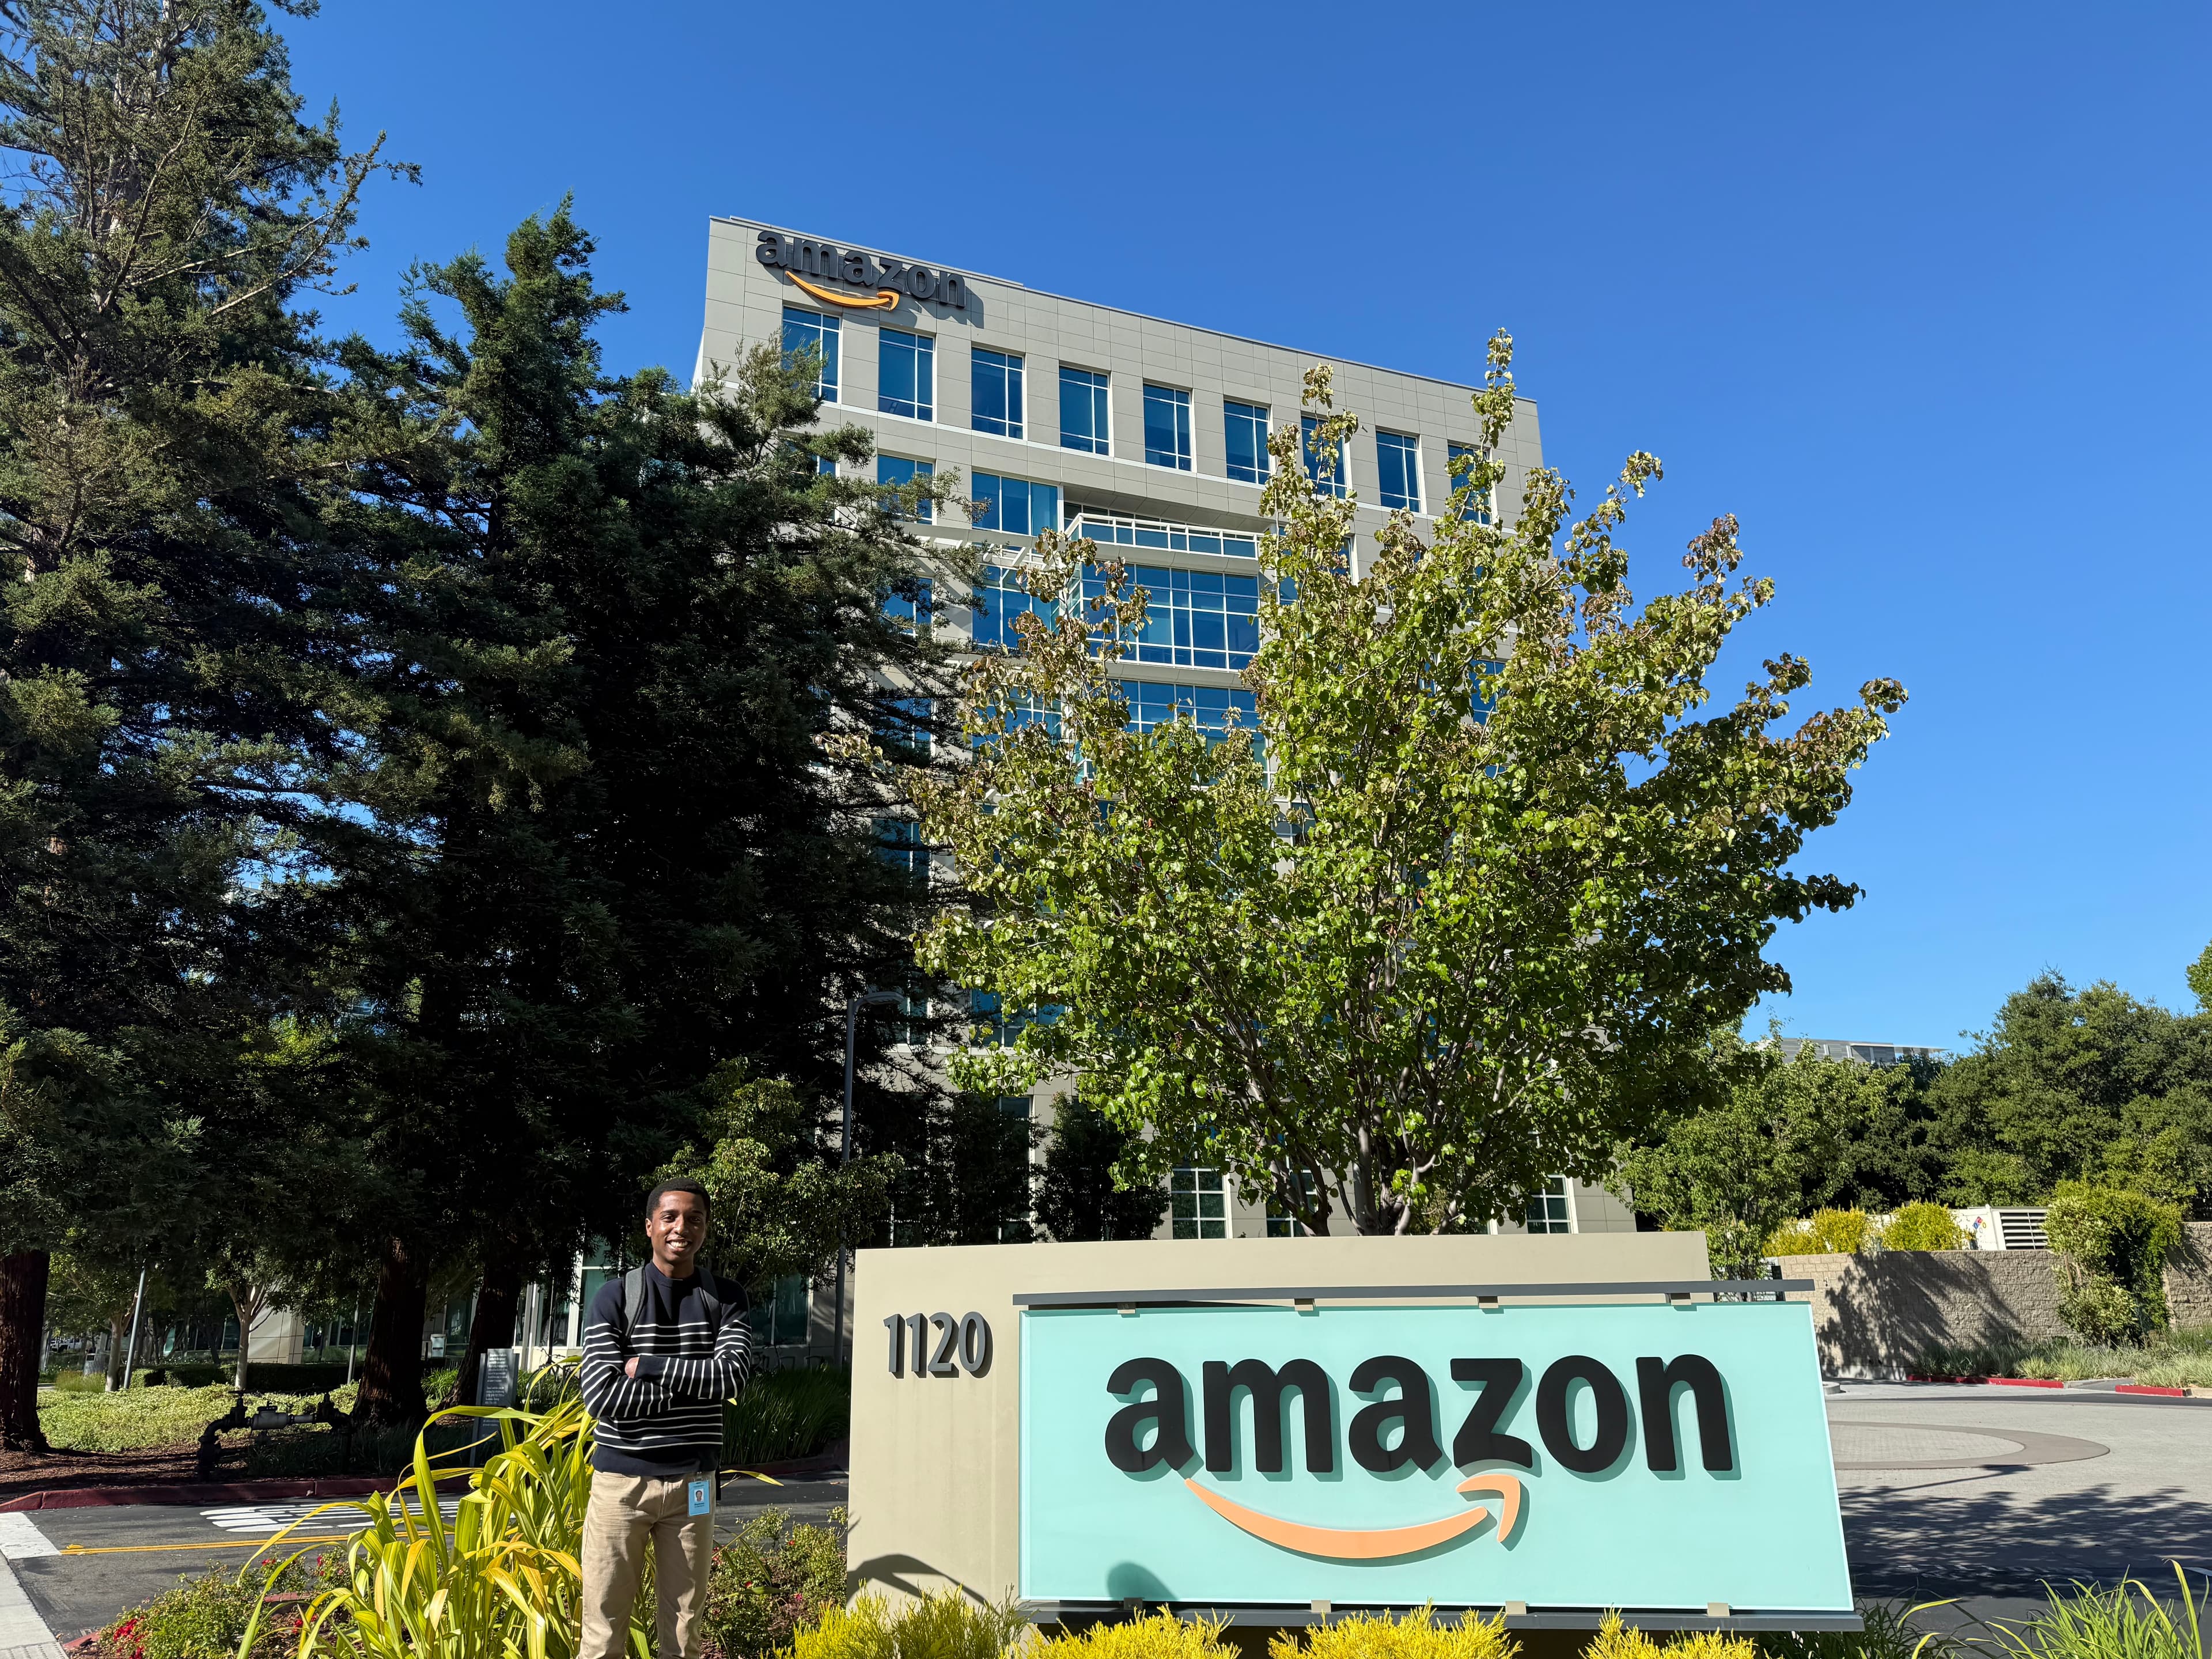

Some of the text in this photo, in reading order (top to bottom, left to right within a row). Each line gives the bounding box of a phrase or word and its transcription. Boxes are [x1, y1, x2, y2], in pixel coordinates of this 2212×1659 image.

[756, 230, 966, 309] amazon
[883, 1311, 990, 1376] 1120
[1105, 1354, 1733, 1474] amazon
